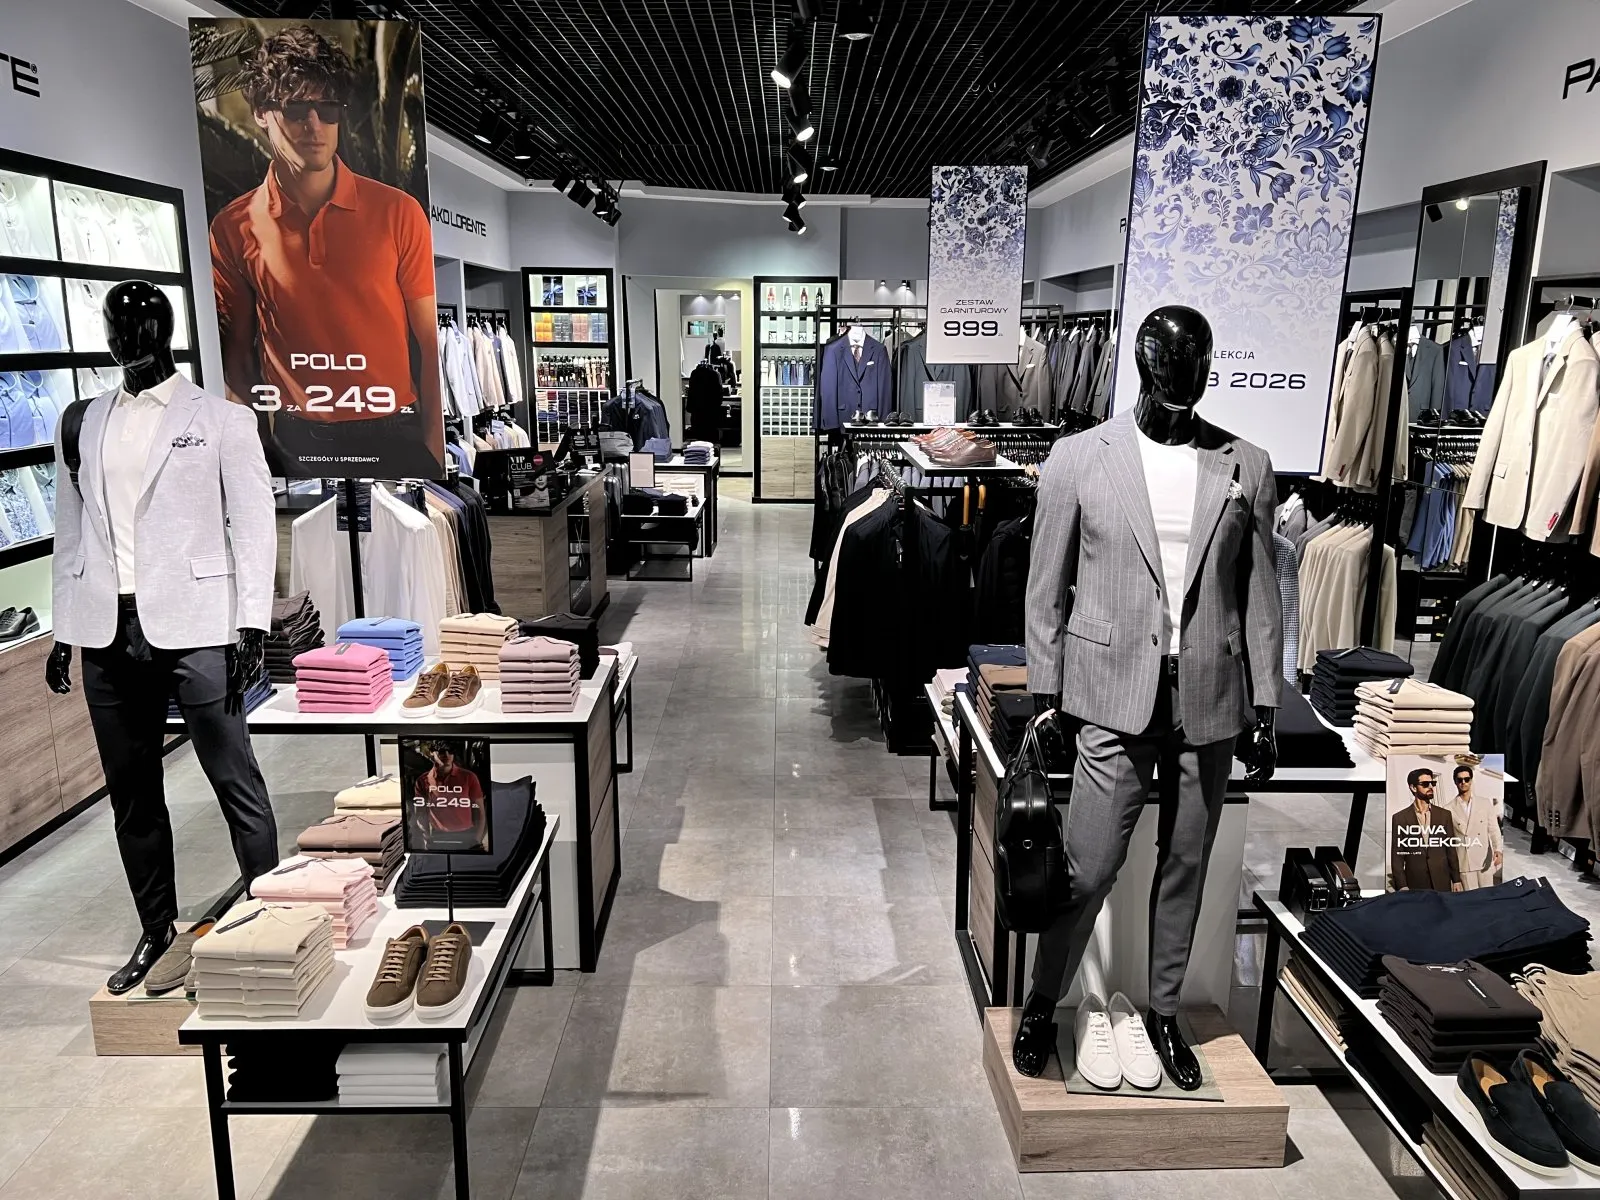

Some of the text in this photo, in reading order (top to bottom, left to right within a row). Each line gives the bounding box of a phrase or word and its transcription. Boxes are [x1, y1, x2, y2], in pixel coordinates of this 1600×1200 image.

[450, 211, 487, 237] LORENTE
[943, 320, 999, 337] 999
[290, 353, 367, 371] POLO
[1229, 372, 1307, 390] 2026
[250, 384, 282, 412] 3
[286, 404, 302, 412] ZA
[304, 385, 397, 413] 249
[510, 456, 526, 464] VIP
[510, 462, 533, 471] CLUB
[413, 797, 426, 807] 3
[436, 797, 471, 808] 249
[1397, 825, 1447, 835] NOWA
[1397, 837, 1483, 848] KOLEKCJA
